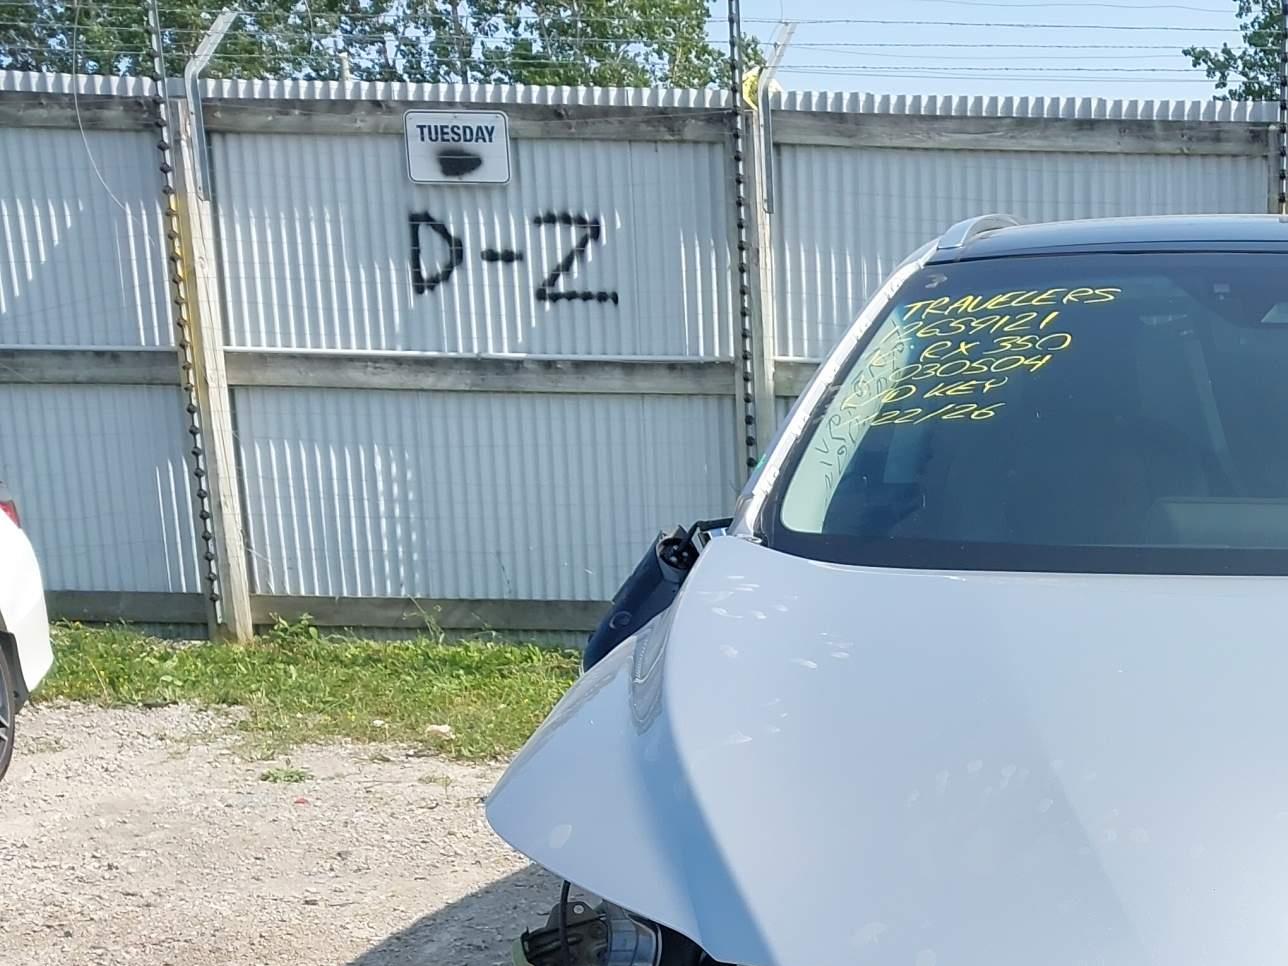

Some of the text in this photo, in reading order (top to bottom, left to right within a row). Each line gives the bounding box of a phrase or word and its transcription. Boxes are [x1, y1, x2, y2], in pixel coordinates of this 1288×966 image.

[416, 124, 495, 143] TUESDAY
[903, 288, 1121, 320] TRAVELERS
[919, 341, 980, 362] RX
[982, 333, 1072, 354] 350
[923, 376, 1008, 399] KEY
